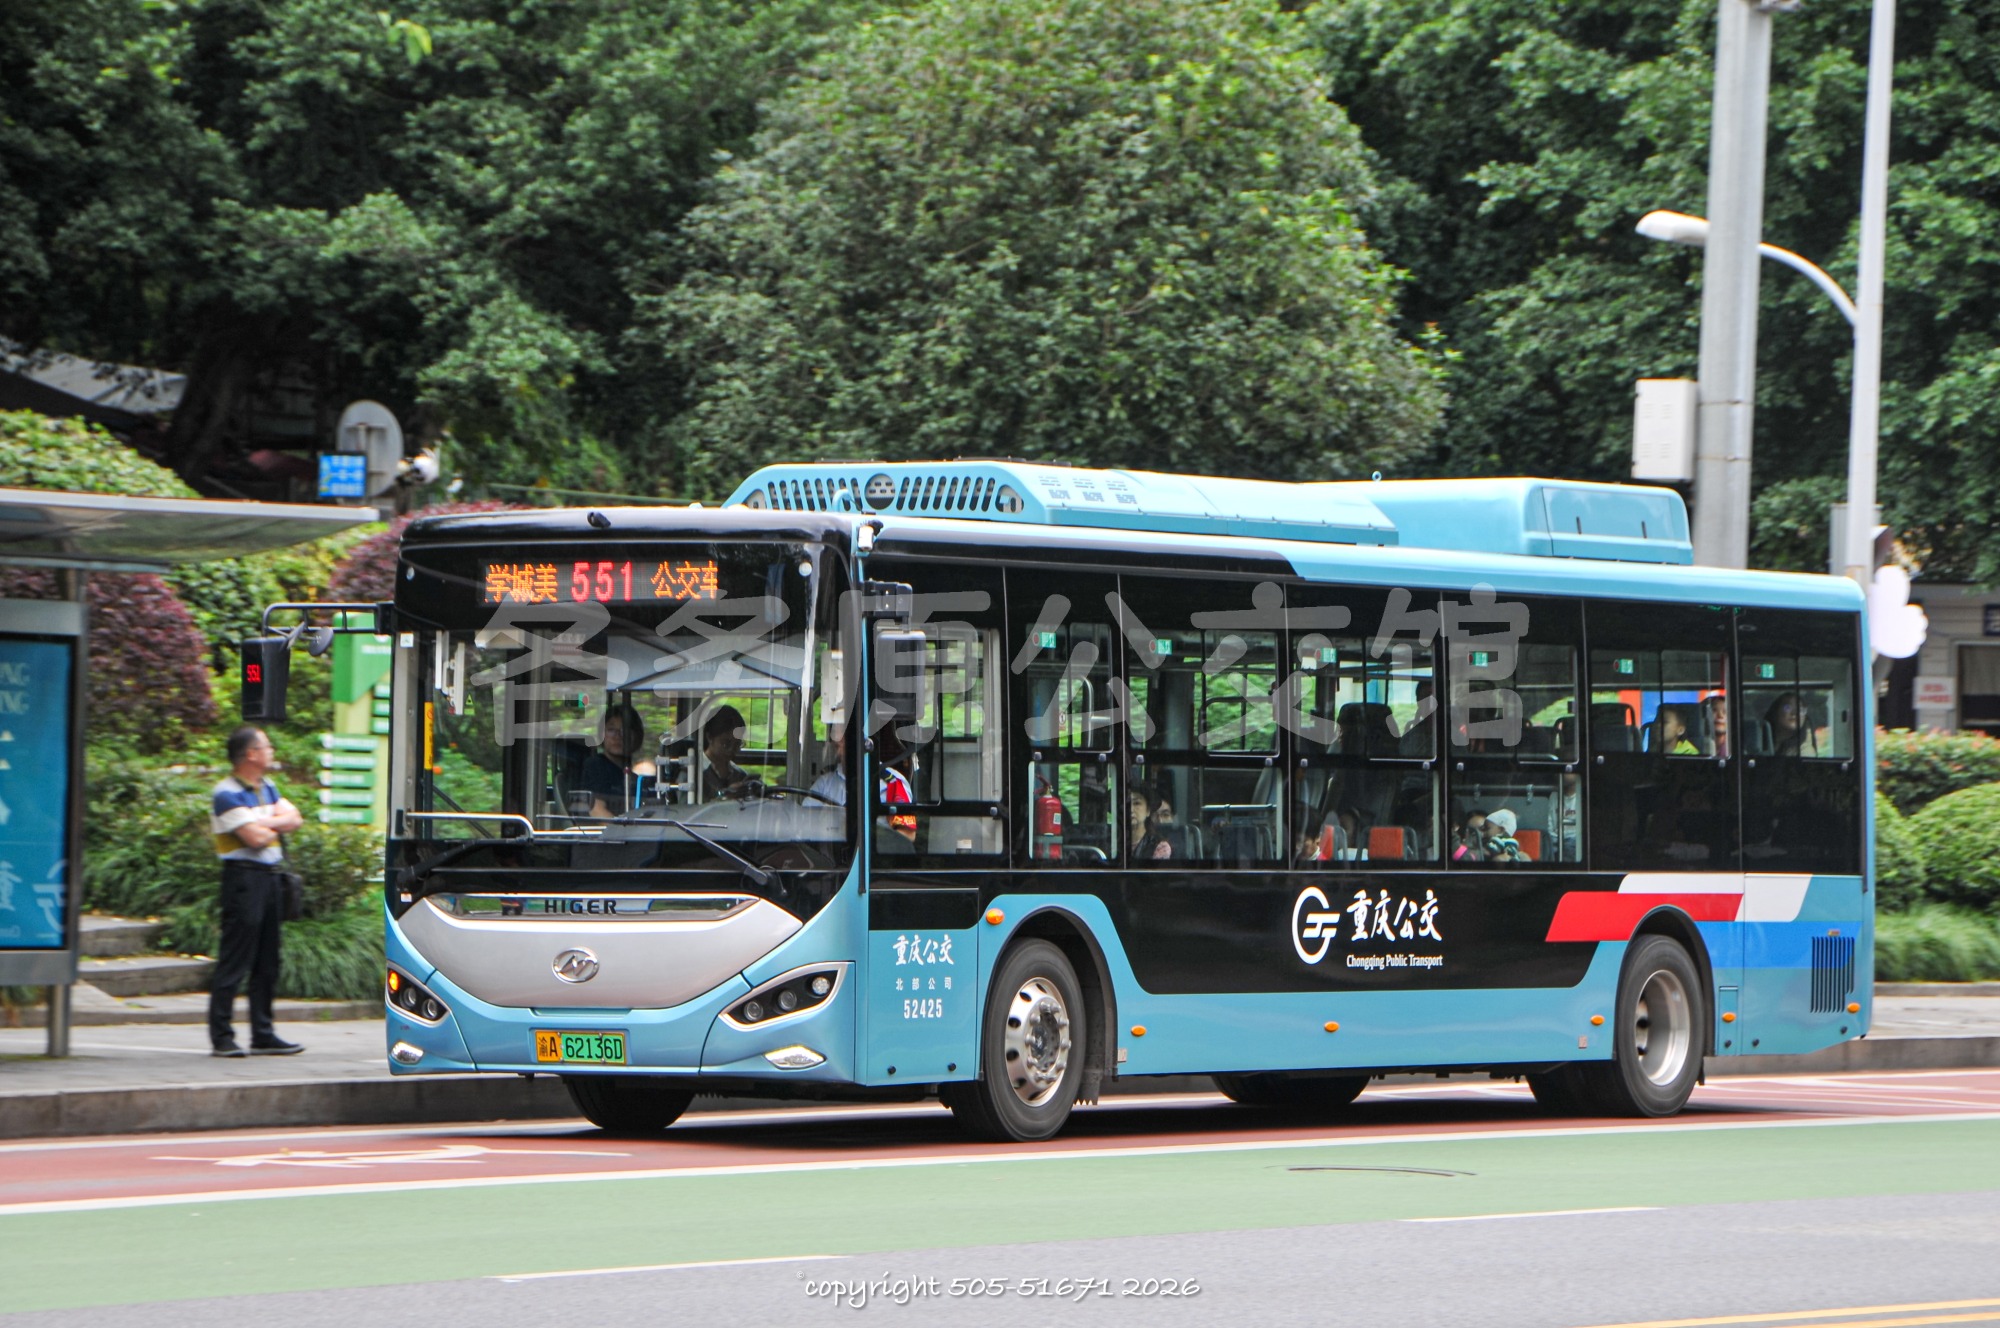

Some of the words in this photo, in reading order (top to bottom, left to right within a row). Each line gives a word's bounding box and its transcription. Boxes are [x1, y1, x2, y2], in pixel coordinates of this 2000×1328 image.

[571, 561, 633, 602] 551
[247, 664, 261, 683] 551
[544, 899, 617, 914] HIGER
[1346, 888, 1443, 942] 重庆公交
[892, 934, 954, 966] 重庆公交
[1346, 954, 1385, 970] Chongqing
[1386, 953, 1408, 967] Public
[1408, 953, 1443, 970] Transport
[903, 998, 943, 1019] 52425
